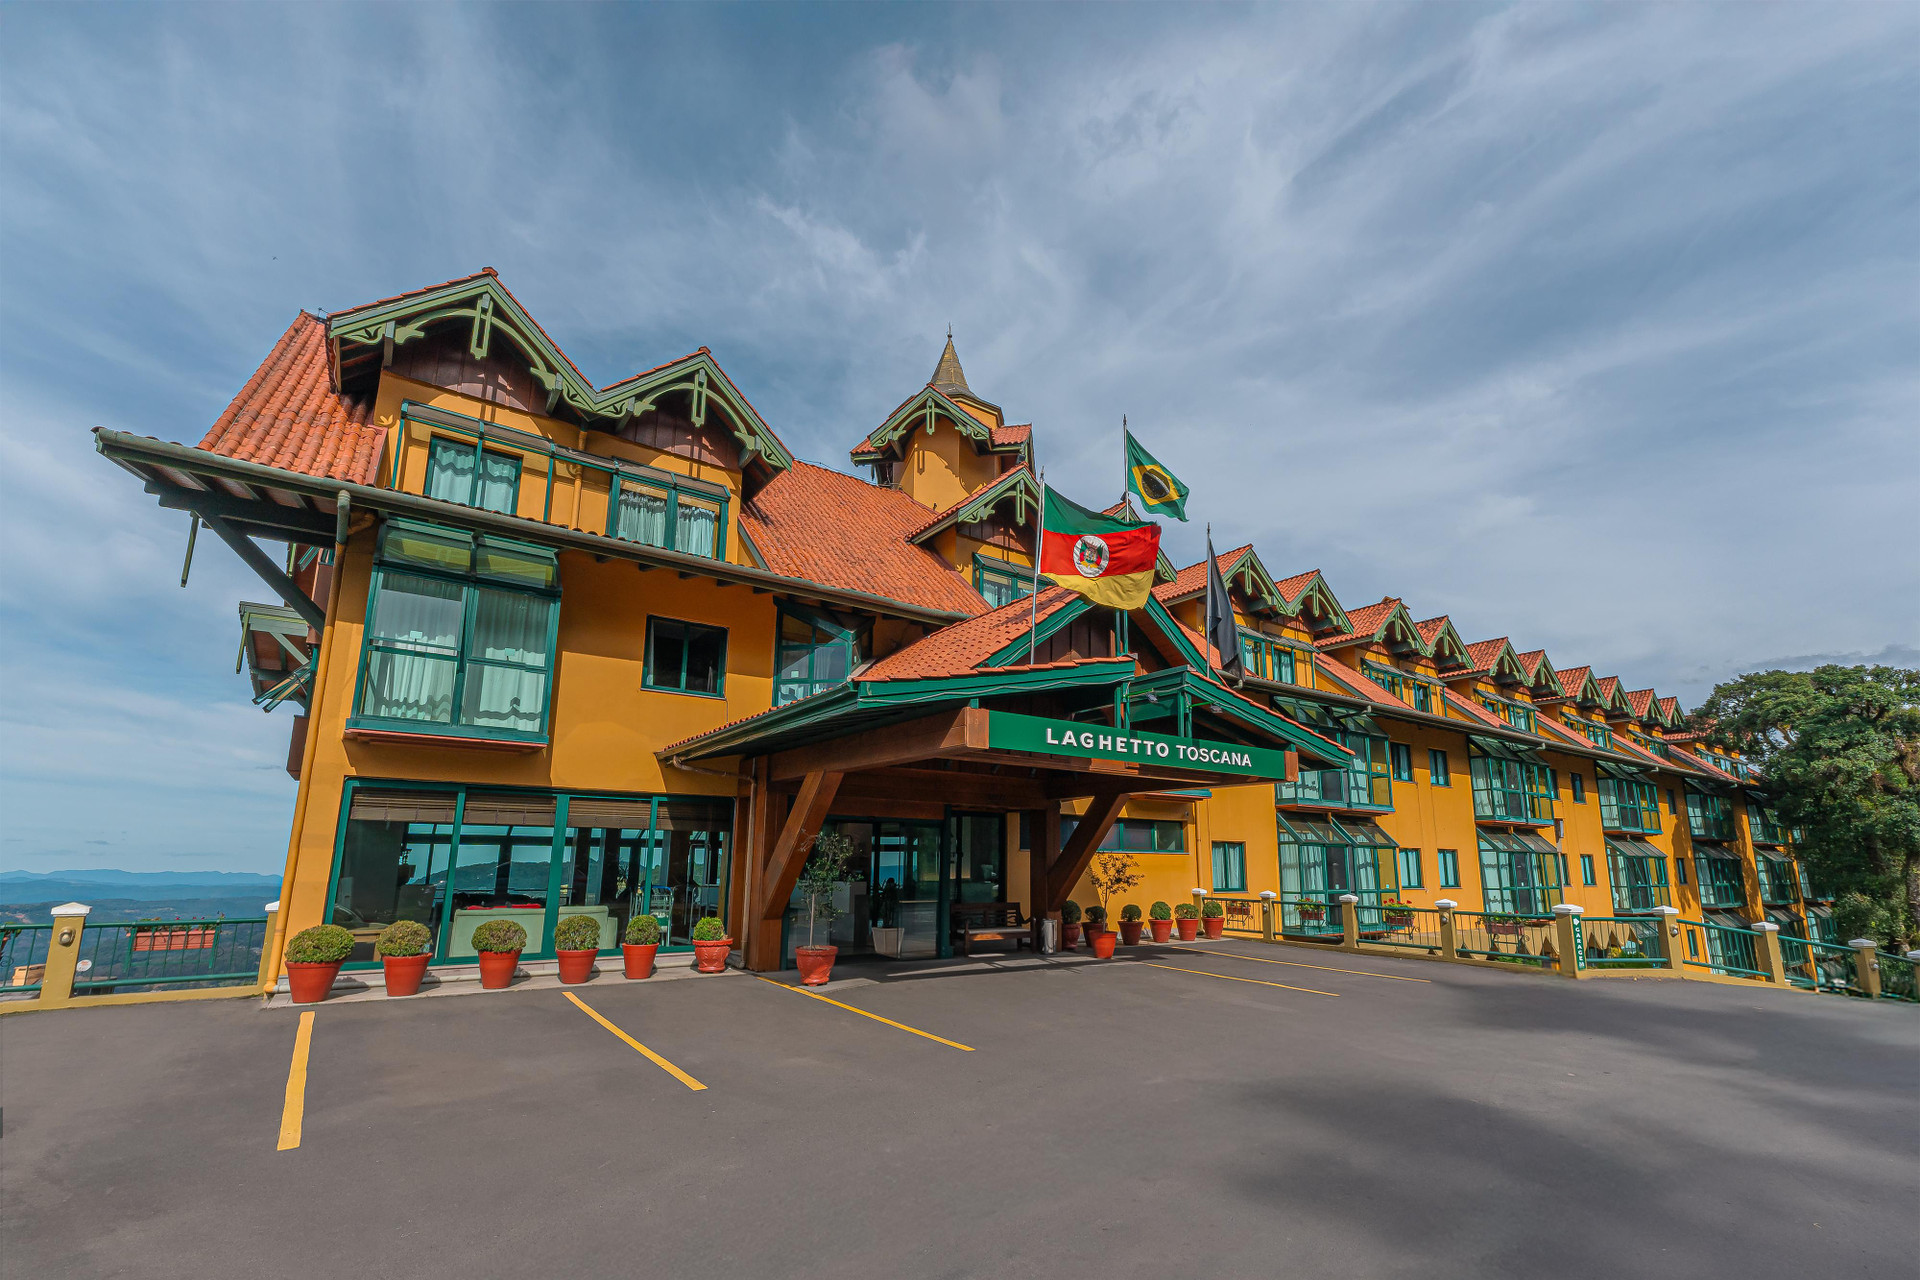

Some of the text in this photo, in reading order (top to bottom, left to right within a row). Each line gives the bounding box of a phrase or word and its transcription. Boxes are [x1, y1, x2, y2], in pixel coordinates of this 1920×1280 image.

[1046, 728, 1251, 767] LAGHETTO TOSCANA
[1575, 927, 1585, 968] GARAGEM
